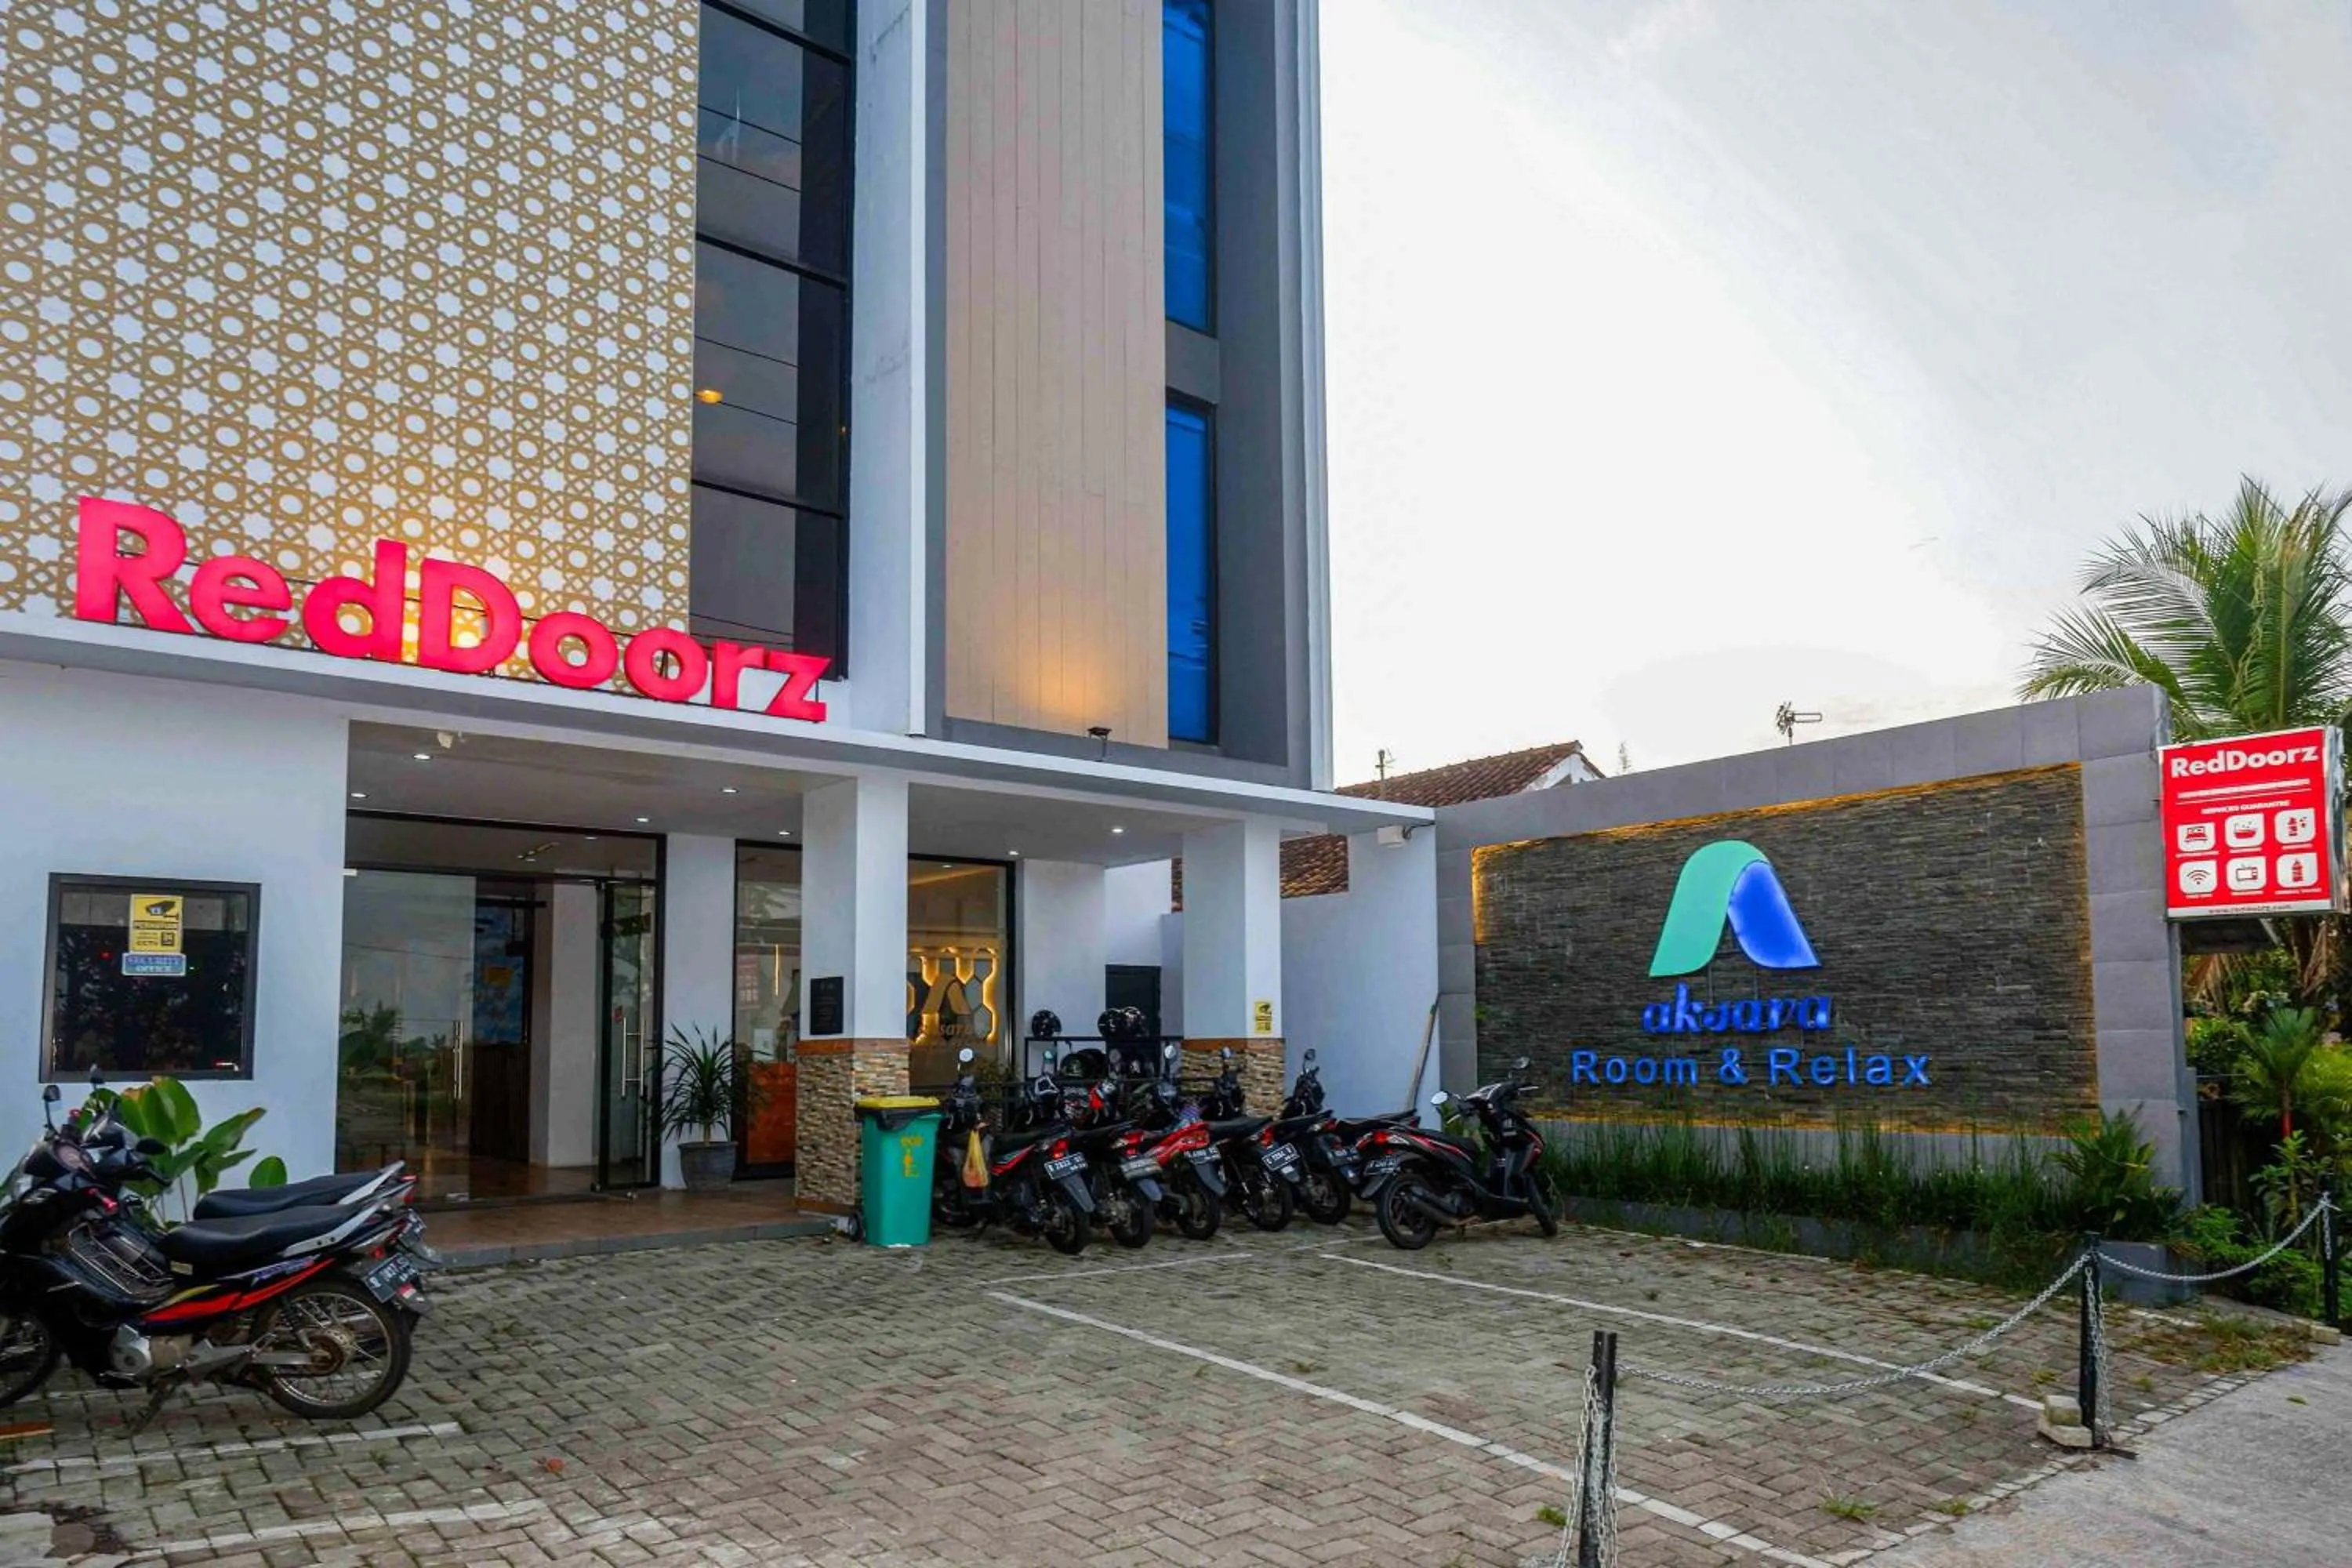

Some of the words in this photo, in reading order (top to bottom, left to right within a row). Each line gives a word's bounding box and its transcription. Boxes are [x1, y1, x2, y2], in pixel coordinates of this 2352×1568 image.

[76, 495, 831, 723] RedDoorz
[2170, 746, 2319, 779] RedDoorz
[1570, 1047, 1699, 1087] Room
[1718, 1047, 1749, 1087] &
[1768, 1047, 1933, 1087] Relax
